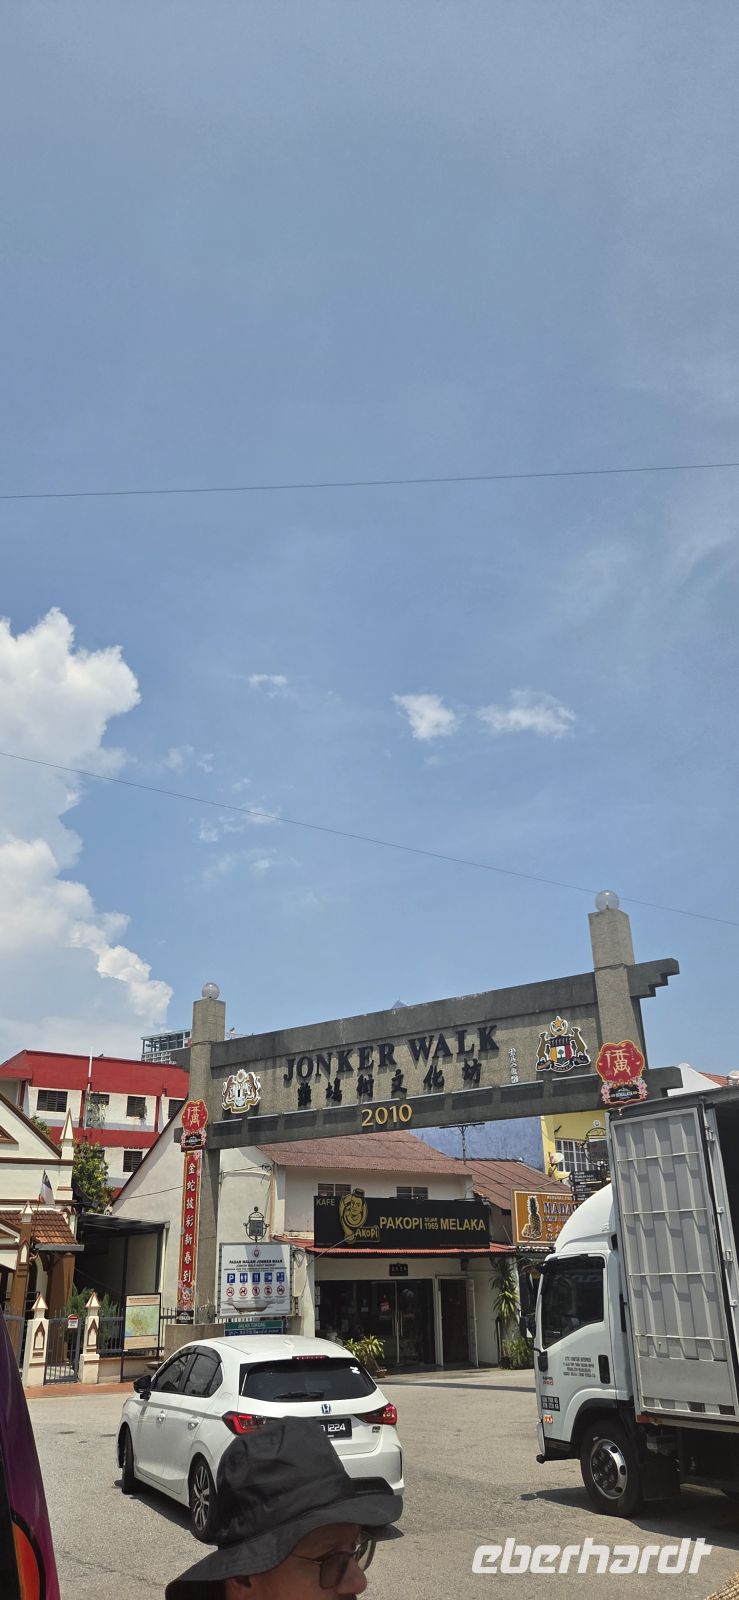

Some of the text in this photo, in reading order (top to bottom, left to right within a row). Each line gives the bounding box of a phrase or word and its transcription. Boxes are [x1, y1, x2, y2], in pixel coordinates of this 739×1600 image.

[284, 1025, 499, 1082] JONKER WALK
[361, 1104, 411, 1127] 2010
[316, 1199, 335, 1207] KAFE
[380, 1217, 422, 1230] PAKOPI
[424, 1222, 438, 1230] 1969
[440, 1218, 486, 1231] MELAKA
